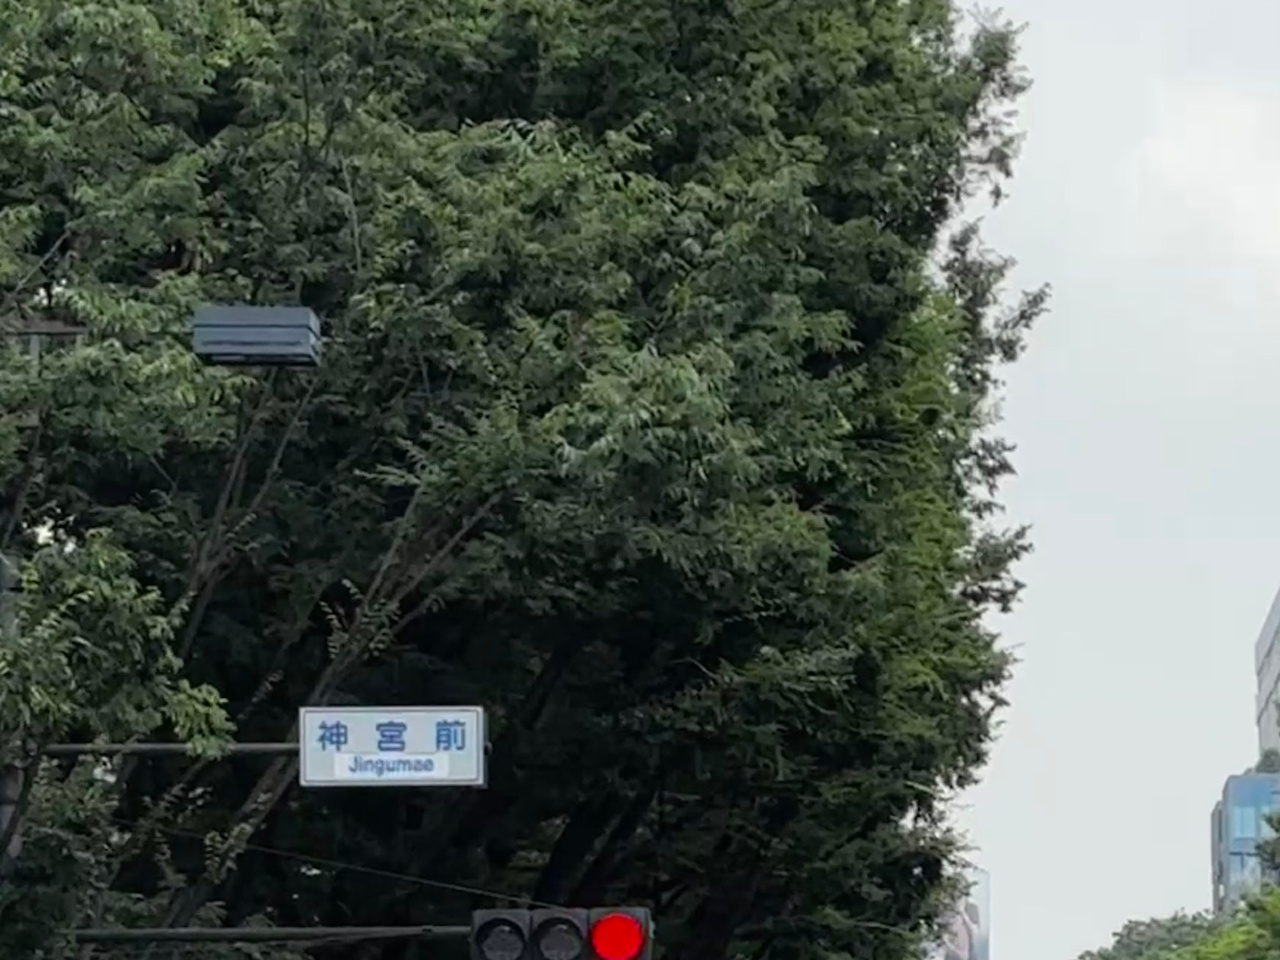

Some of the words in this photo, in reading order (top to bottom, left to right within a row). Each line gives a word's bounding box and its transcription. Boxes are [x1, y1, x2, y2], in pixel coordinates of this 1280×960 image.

[317, 720, 466, 752] 神宮前
[348, 757, 435, 776] Jingumae
